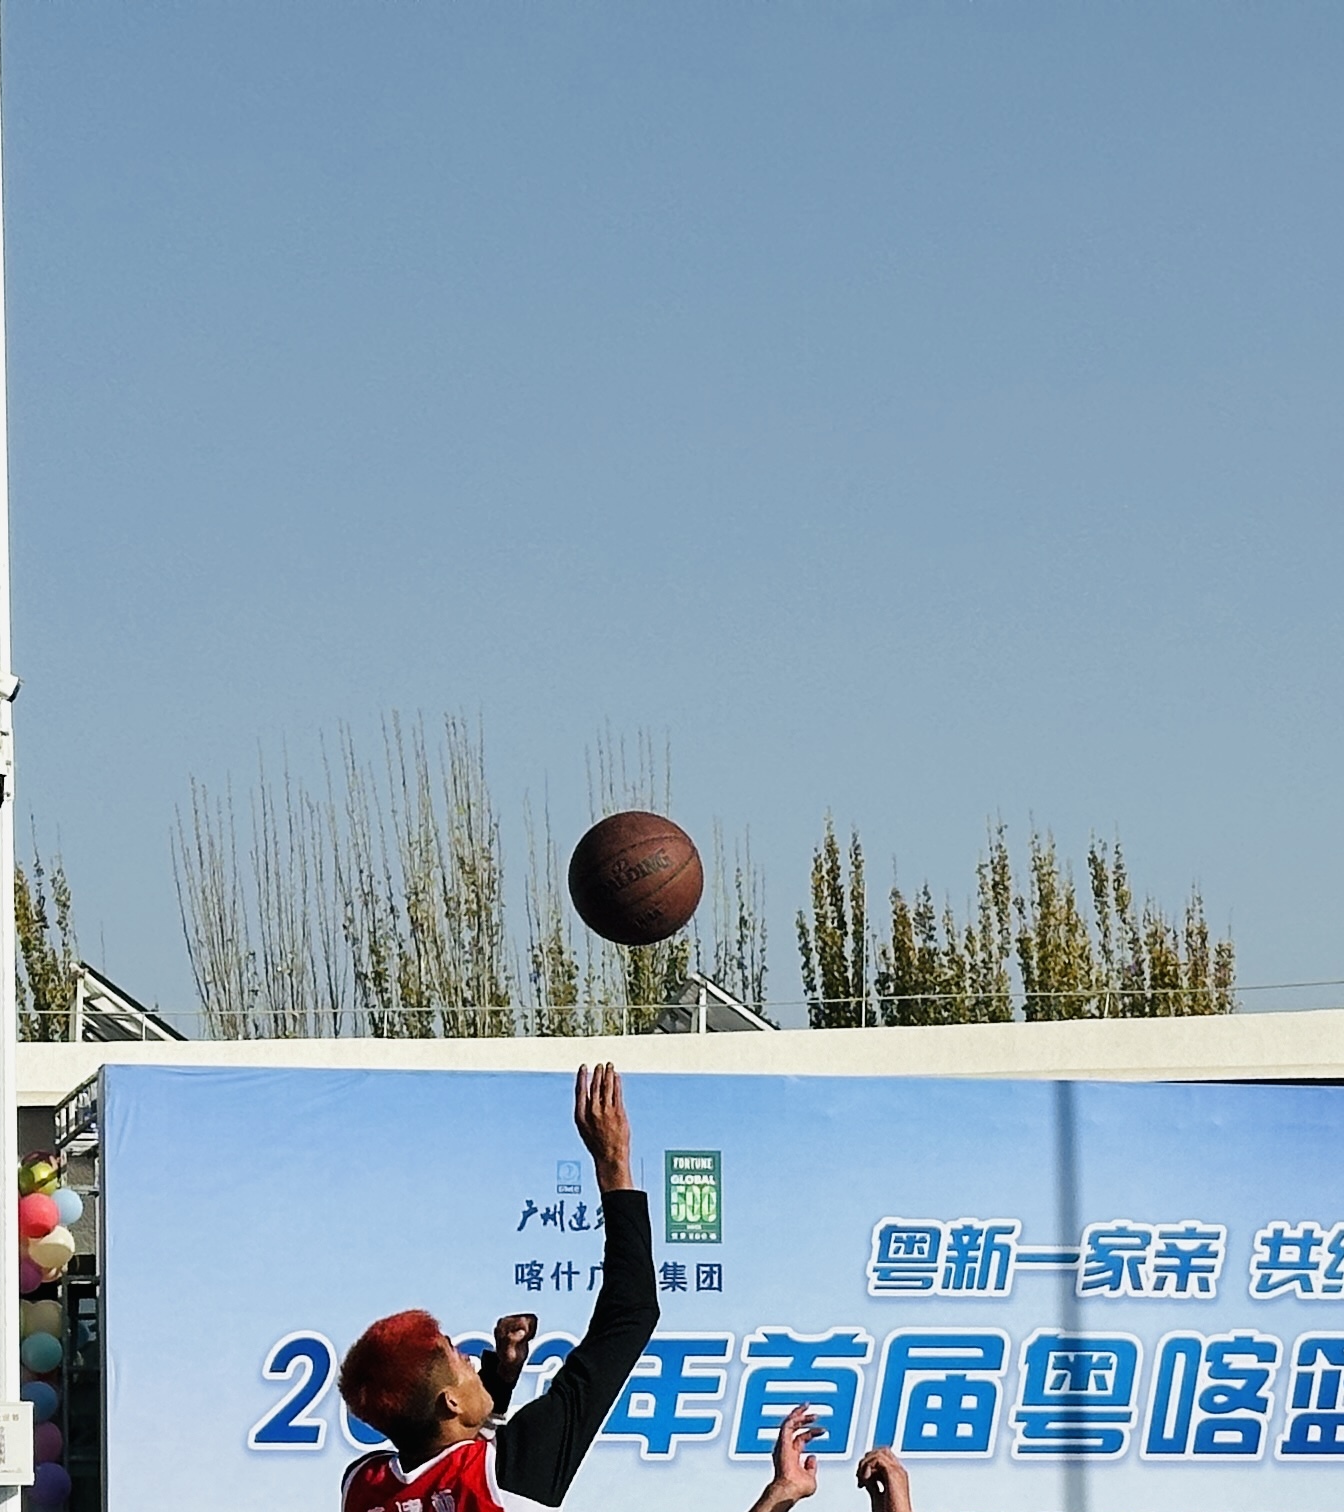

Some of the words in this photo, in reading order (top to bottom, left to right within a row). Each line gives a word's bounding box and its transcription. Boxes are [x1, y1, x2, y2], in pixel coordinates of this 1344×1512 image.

[672, 1156, 713, 1170] FORTUNE
[670, 1174, 716, 1185] GLOBAL
[670, 1185, 717, 1223] 500
[862, 1224, 1223, 1294] 粤新一家亲
